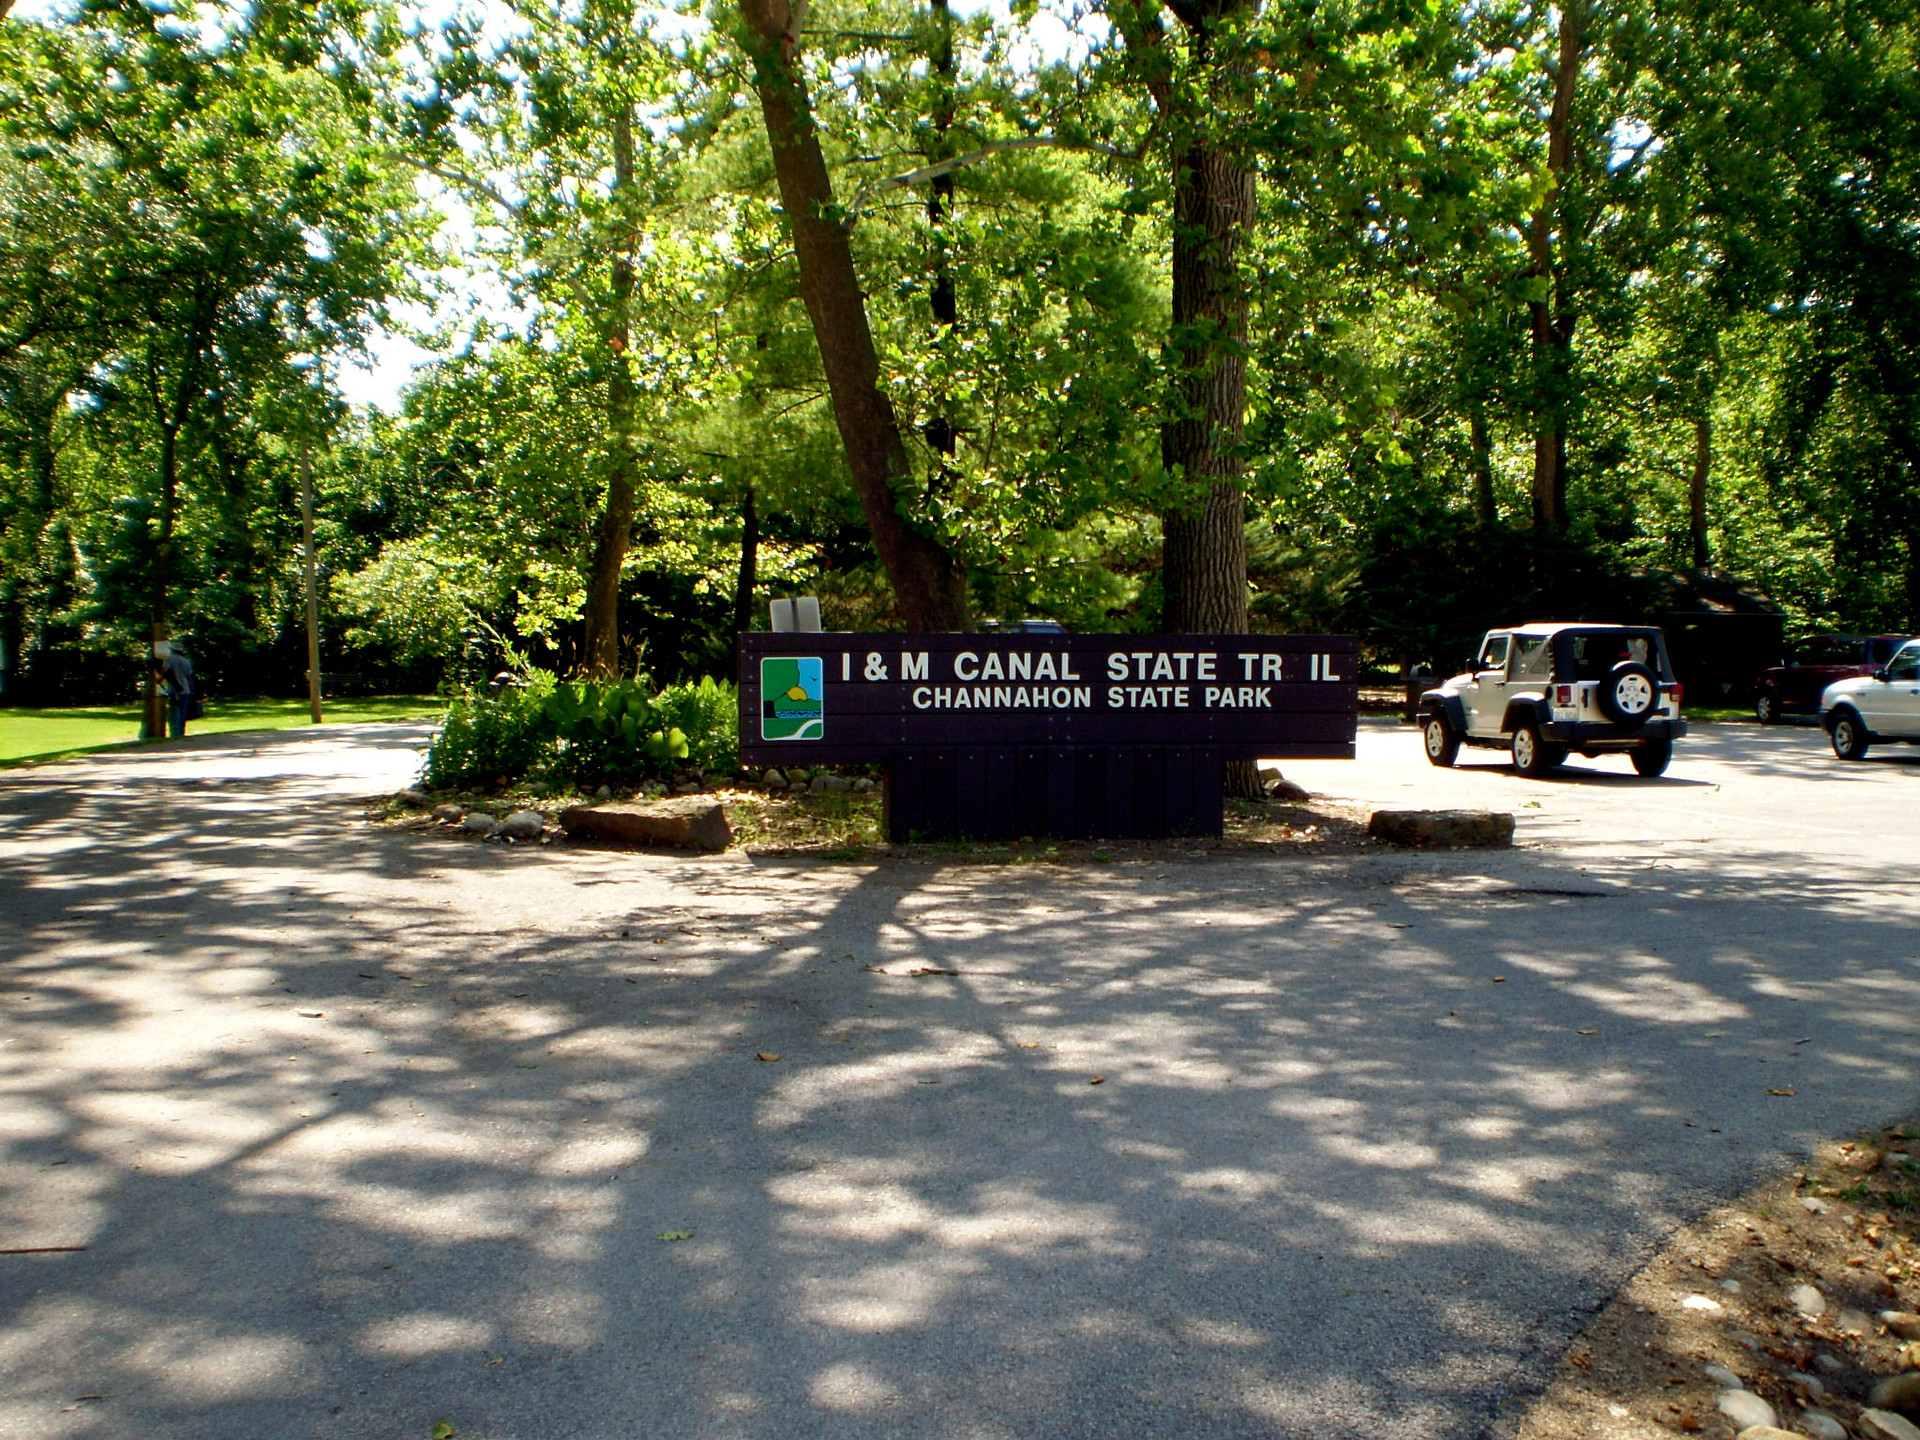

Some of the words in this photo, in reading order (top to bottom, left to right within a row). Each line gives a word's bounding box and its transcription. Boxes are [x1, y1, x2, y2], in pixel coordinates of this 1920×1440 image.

[842, 652, 851, 681] I
[863, 651, 889, 681] &
[901, 651, 929, 681] M
[954, 651, 1080, 681] CANAL
[1107, 652, 1217, 681] STATE
[912, 686, 1091, 709] CHANNAHON
[1107, 686, 1190, 708] STATE
[1205, 686, 1272, 708] PARK
